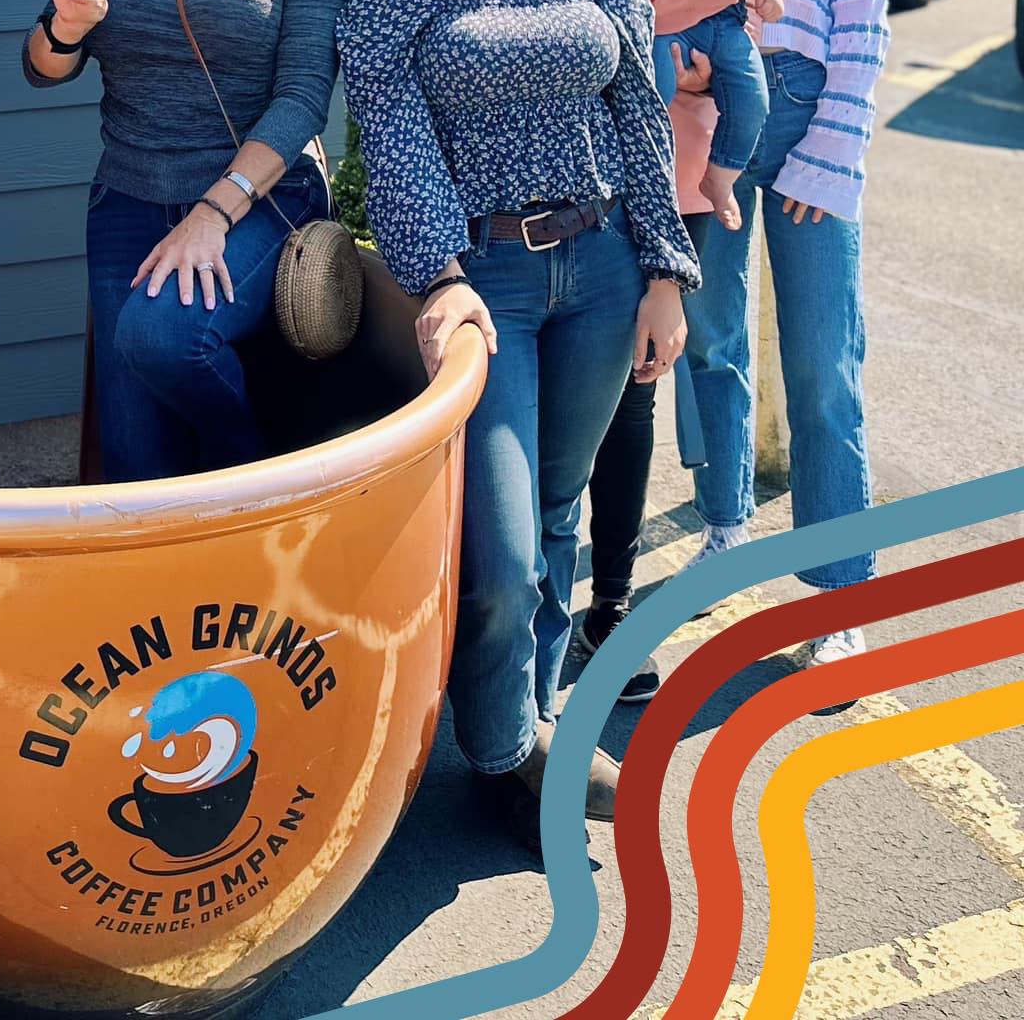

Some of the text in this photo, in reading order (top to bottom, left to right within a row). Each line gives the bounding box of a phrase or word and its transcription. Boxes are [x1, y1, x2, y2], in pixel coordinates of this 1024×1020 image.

[19, 603, 337, 768] OCEAN GRINDS
[46, 784, 315, 916] COFFEE COMPANY
[94, 875, 270, 936] FLORENCE, OREGON
